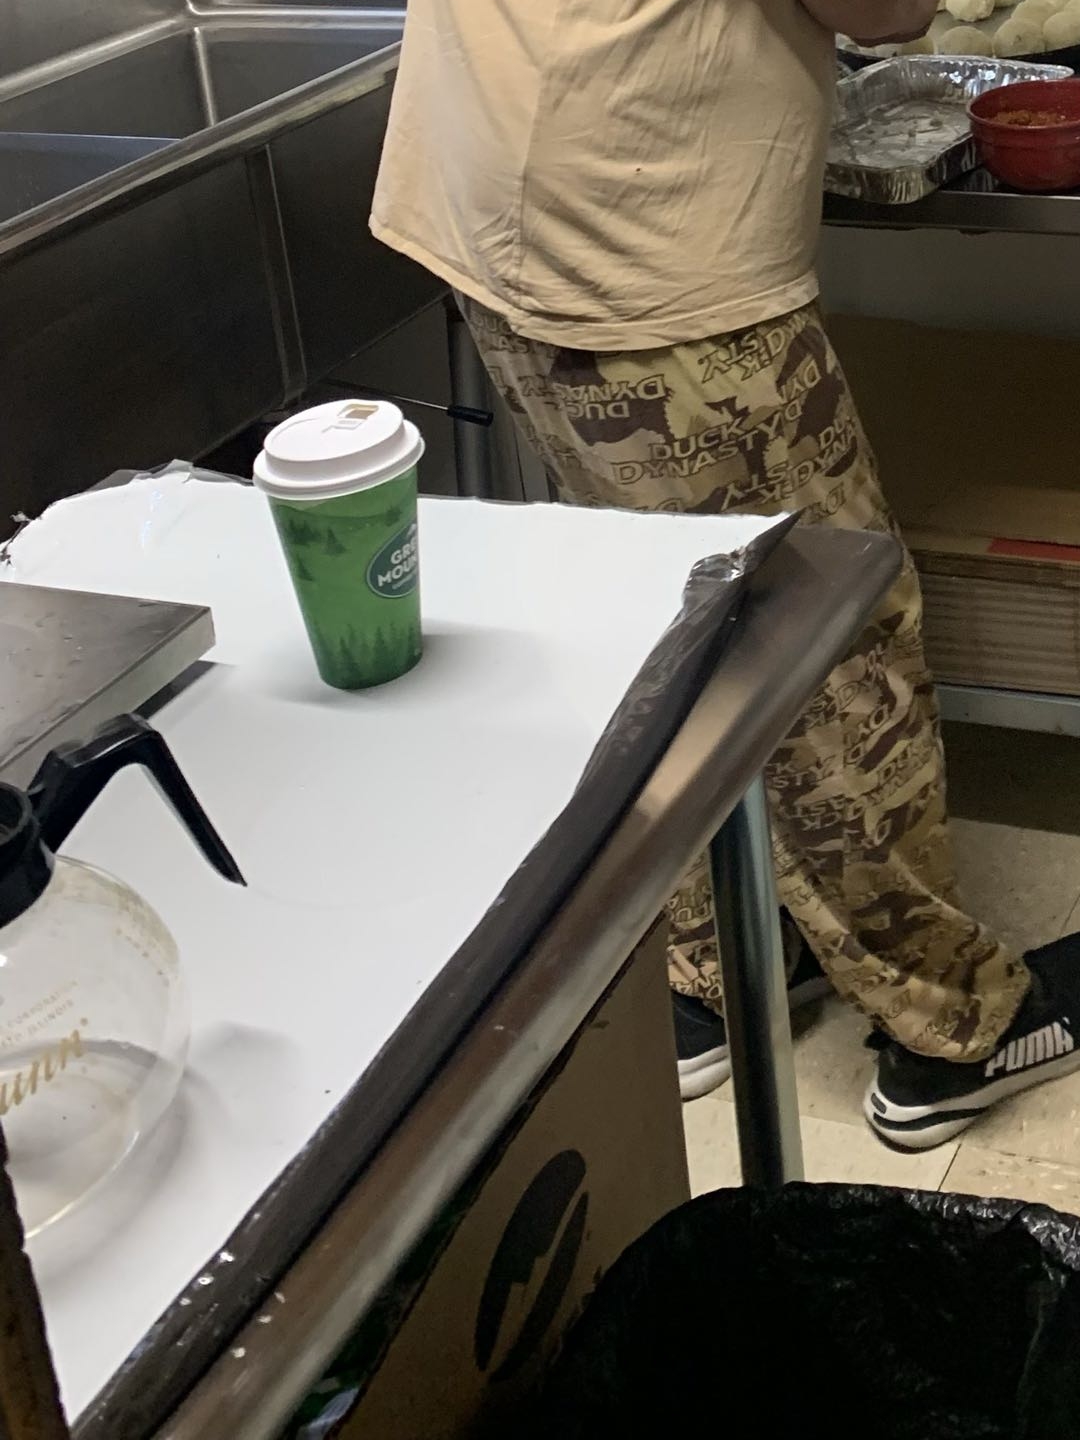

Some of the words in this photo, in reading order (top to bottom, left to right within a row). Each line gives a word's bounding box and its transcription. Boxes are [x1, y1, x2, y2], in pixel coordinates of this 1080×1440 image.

[610, 409, 784, 485] DYNASTY
[648, 415, 747, 462] DUCK
[984, 1021, 1075, 1078] PUMA
